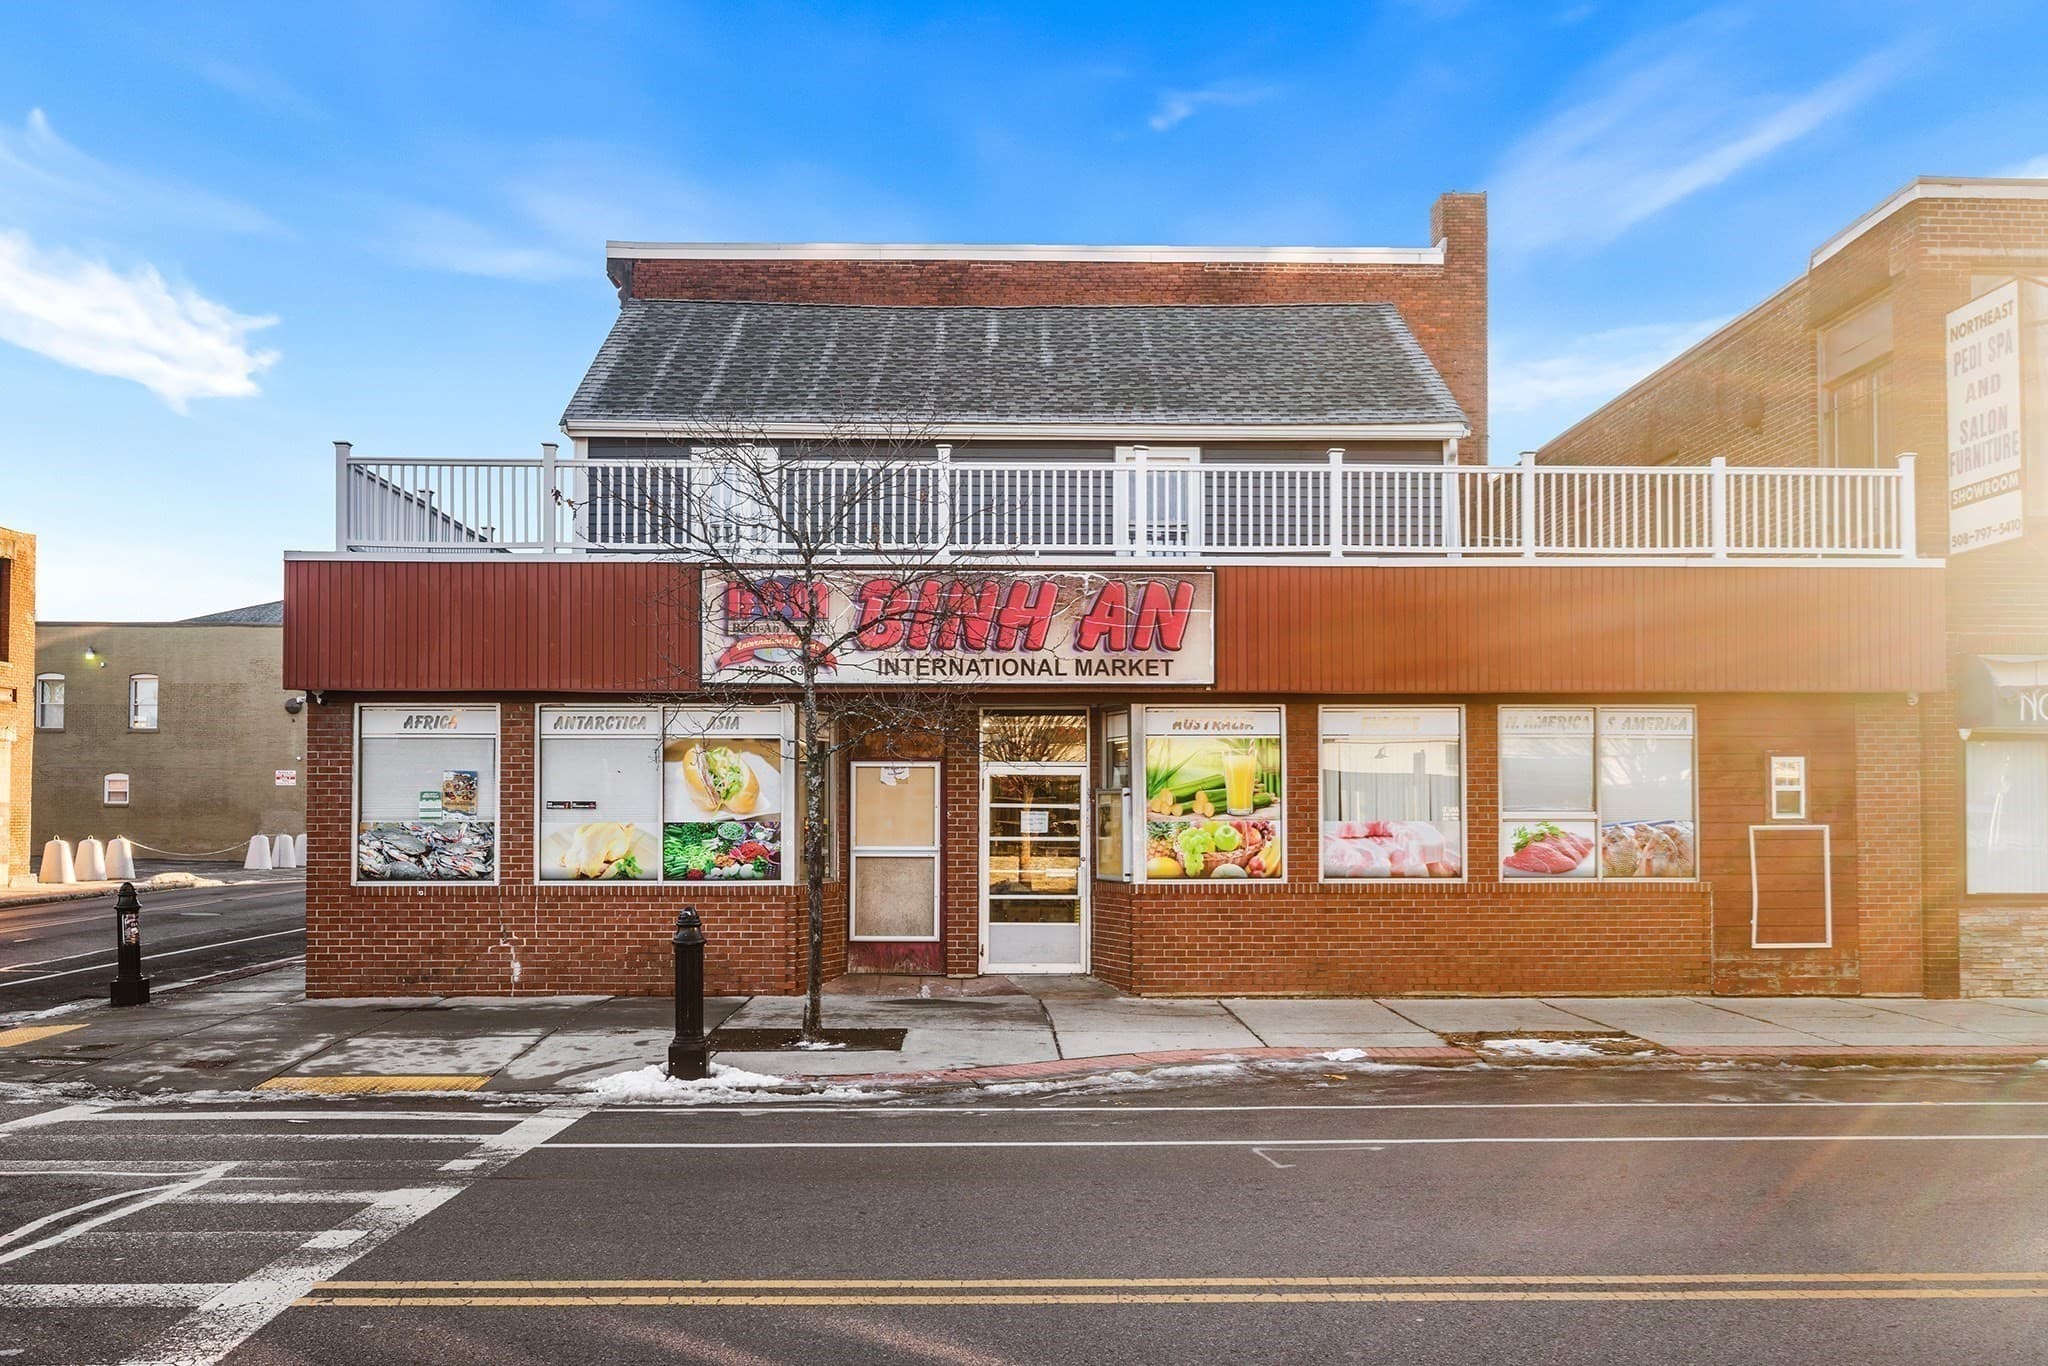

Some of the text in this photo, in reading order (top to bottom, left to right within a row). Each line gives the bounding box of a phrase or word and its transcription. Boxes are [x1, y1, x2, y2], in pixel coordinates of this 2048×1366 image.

[1949, 300, 2014, 343] NORTHEAST
[1953, 328, 2013, 377] PEDI SPA
[1966, 373, 2001, 404] AND
[1959, 405, 2008, 445] SALON
[1950, 429, 2019, 477] FURNITURE
[1952, 473, 2018, 504] SHOWROOM
[854, 578, 1195, 652] BINH AN
[877, 658, 1174, 677] INTERNATIONAL MARKET
[403, 714, 458, 730] AFRICA
[553, 715, 647, 731] ANTARCTICA
[706, 715, 741, 730] ASIA
[1622, 716, 1688, 731] AMERICA
